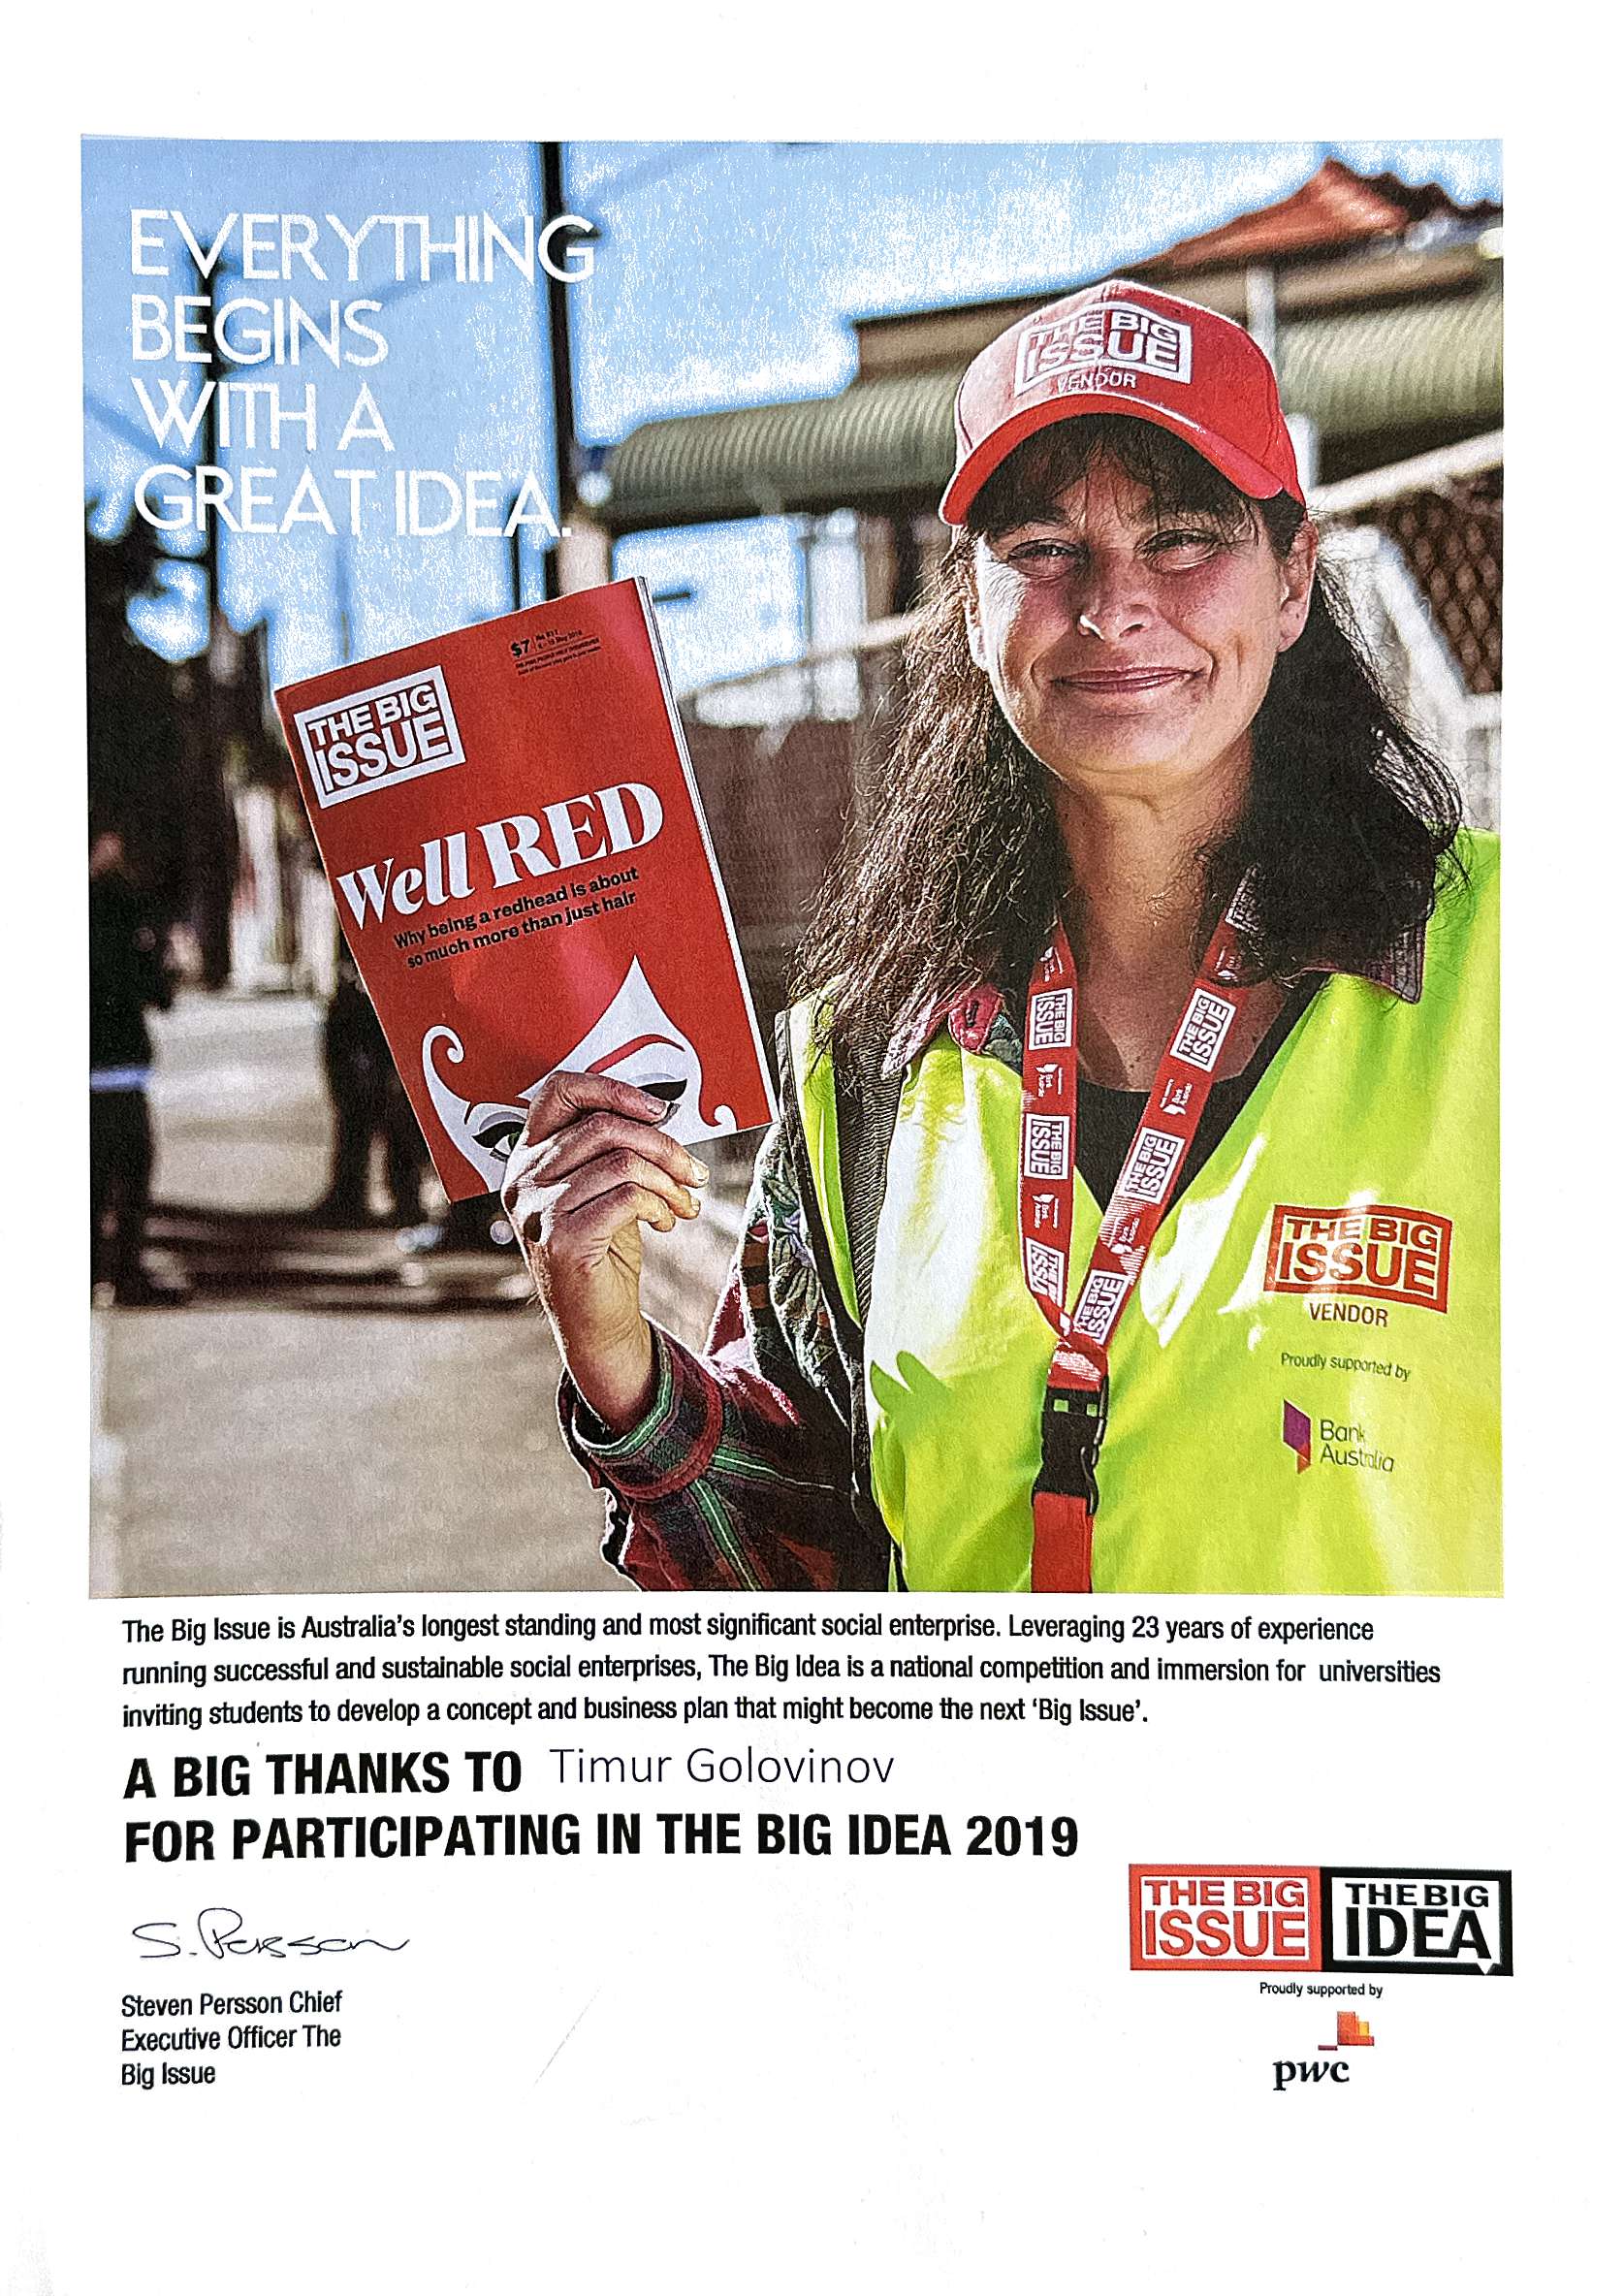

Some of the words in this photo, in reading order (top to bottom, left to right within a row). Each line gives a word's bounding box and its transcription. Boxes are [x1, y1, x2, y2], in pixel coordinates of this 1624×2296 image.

[130, 208, 595, 284] EVERYTHING
[131, 294, 388, 368] BEGINS
[1029, 309, 1103, 347] THE
[1110, 311, 1179, 342] BIG
[1025, 331, 1179, 384] ISSUE
[1058, 371, 1137, 394] VENDOR
[131, 377, 317, 452] WITH
[336, 383, 396, 452] A
[134, 464, 376, 536] GREAT
[396, 469, 572, 538] IDEA.
[511, 638, 530, 658] $7
[307, 704, 374, 747] THE
[374, 684, 438, 725] BIG
[314, 710, 451, 793] ISSUE
[336, 831, 476, 931] Well
[476, 781, 665, 890] RED
[394, 929, 427, 950] Why
[428, 912, 478, 940] being
[479, 909, 492, 924] a
[493, 884, 569, 921] redhead
[570, 880, 588, 898] is
[589, 866, 640, 894] about
[407, 952, 424, 969] so
[425, 937, 470, 964] much
[473, 925, 520, 949] more
[522, 911, 563, 936] than
[564, 898, 601, 927] just
[601, 890, 637, 913] hair
[1035, 996, 1056, 1045] ISSUE
[1053, 1019, 1066, 1042] BIG
[1054, 994, 1067, 1019] THE
[1178, 1019, 1198, 1054] THE
[1193, 996, 1212, 1022] BIG
[1193, 1002, 1229, 1065] ISSUE
[1030, 1120, 1052, 1174] ISSUE
[1050, 1122, 1064, 1151] THE
[1049, 1152, 1063, 1175] BIG
[1125, 1164, 1148, 1193] THE
[1138, 1135, 1158, 1162] BIG
[1134, 1137, 1177, 1197] ISSUE
[1287, 1218, 1362, 1243] THE
[1369, 1217, 1438, 1253] BIG
[1031, 1246, 1050, 1296] ISSU
[1087, 1277, 1105, 1305] BIG
[1279, 1242, 1437, 1296] ISSUE
[1083, 1279, 1123, 1338] ISSUE
[1309, 1302, 1388, 1328] VENDOR
[1281, 1352, 1327, 1370] Proudly
[1329, 1356, 1391, 1378] supported
[1394, 1365, 1412, 1383] by
[1321, 1419, 1366, 1442] Bank
[121, 1619, 165, 1643] The
[172, 1617, 207, 1647] Big
[213, 1616, 271, 1641] Issue
[277, 1615, 296, 1640] is
[301, 1613, 415, 1639] Australia’s
[422, 1613, 500, 1642] longest
[504, 1612, 596, 1642] standing
[602, 1612, 642, 1636] and
[649, 1612, 702, 1636] most
[706, 1611, 817, 1642] significant
[821, 1612, 882, 1637] social
[889, 1613, 1002, 1642] enterprise.
[1008, 1613, 1125, 1643] Leveraging
[1131, 1614, 1160, 1639] 23
[1164, 1620, 1225, 1643] years
[1230, 1615, 1253, 1640] of
[1258, 1616, 1374, 1645] experience
[122, 1660, 207, 1689] running
[213, 1656, 329, 1682] successful
[334, 1655, 376, 1680] and
[381, 1654, 504, 1679] sustainable
[510, 1654, 571, 1678] social
[578, 1653, 702, 1682] enterprises,
[708, 1653, 748, 1677] The
[755, 1653, 789, 1683] Big
[795, 1653, 842, 1677] Idea
[846, 1654, 865, 1677] is
[870, 1659, 885, 1677] a
[889, 1654, 973, 1678] national
[979, 1656, 1104, 1684] competition
[1110, 1656, 1150, 1680] and
[1157, 1657, 1269, 1681] immersion
[1275, 1658, 1307, 1682] for
[1319, 1659, 1441, 1684] universities
[122, 1703, 203, 1731] inviting
[208, 1700, 303, 1725] students
[307, 1699, 331, 1722] to
[336, 1698, 421, 1727] develop
[427, 1702, 441, 1721] a
[446, 1697, 533, 1726] concept
[537, 1696, 577, 1720] and
[584, 1696, 678, 1719] business
[684, 1695, 728, 1724] plan
[734, 1695, 778, 1719] that
[782, 1696, 844, 1725] might
[849, 1696, 934, 1720] become
[939, 1697, 973, 1720] the
[979, 1698, 1026, 1721] next
[1032, 1698, 1072, 1727] ‘Big
[1079, 1698, 1148, 1723] Issue’.
[122, 1757, 157, 1800] A
[174, 1754, 250, 1798] BIG
[265, 1751, 450, 1796] THANKS
[464, 1750, 522, 1793] TO
[549, 1747, 673, 1784] Timur
[686, 1745, 895, 1784] Golovinov
[125, 1819, 215, 1864] FOR
[233, 1813, 581, 1861] PARTICIPATING
[596, 1812, 641, 1855] IN
[655, 1812, 742, 1855] THE
[757, 1813, 832, 1856] BIG
[848, 1813, 952, 1856] IDEA
[966, 1815, 1078, 1858] 2019
[1143, 1879, 1226, 1907] THE
[1233, 1880, 1305, 1908] BIG
[1345, 1883, 1417, 1906] THE
[1424, 1884, 1490, 1908] BIG
[1144, 1908, 1306, 1958] ISSUE
[1346, 1906, 1492, 1960] IDEA
[121, 1993, 193, 2018] Steven
[200, 1993, 283, 2016] Persson
[289, 1990, 343, 2014] Chief
[1259, 1981, 1304, 1998] Proudly
[1306, 1983, 1366, 1998] supported
[1368, 1983, 1384, 1999] by
[121, 2026, 221, 2052] Executive
[227, 2025, 298, 2050] Officer
[302, 2024, 342, 2048] The
[121, 2062, 155, 2090] Big
[162, 2061, 216, 2086] Issue
[1272, 2060, 1351, 2091] pwc
